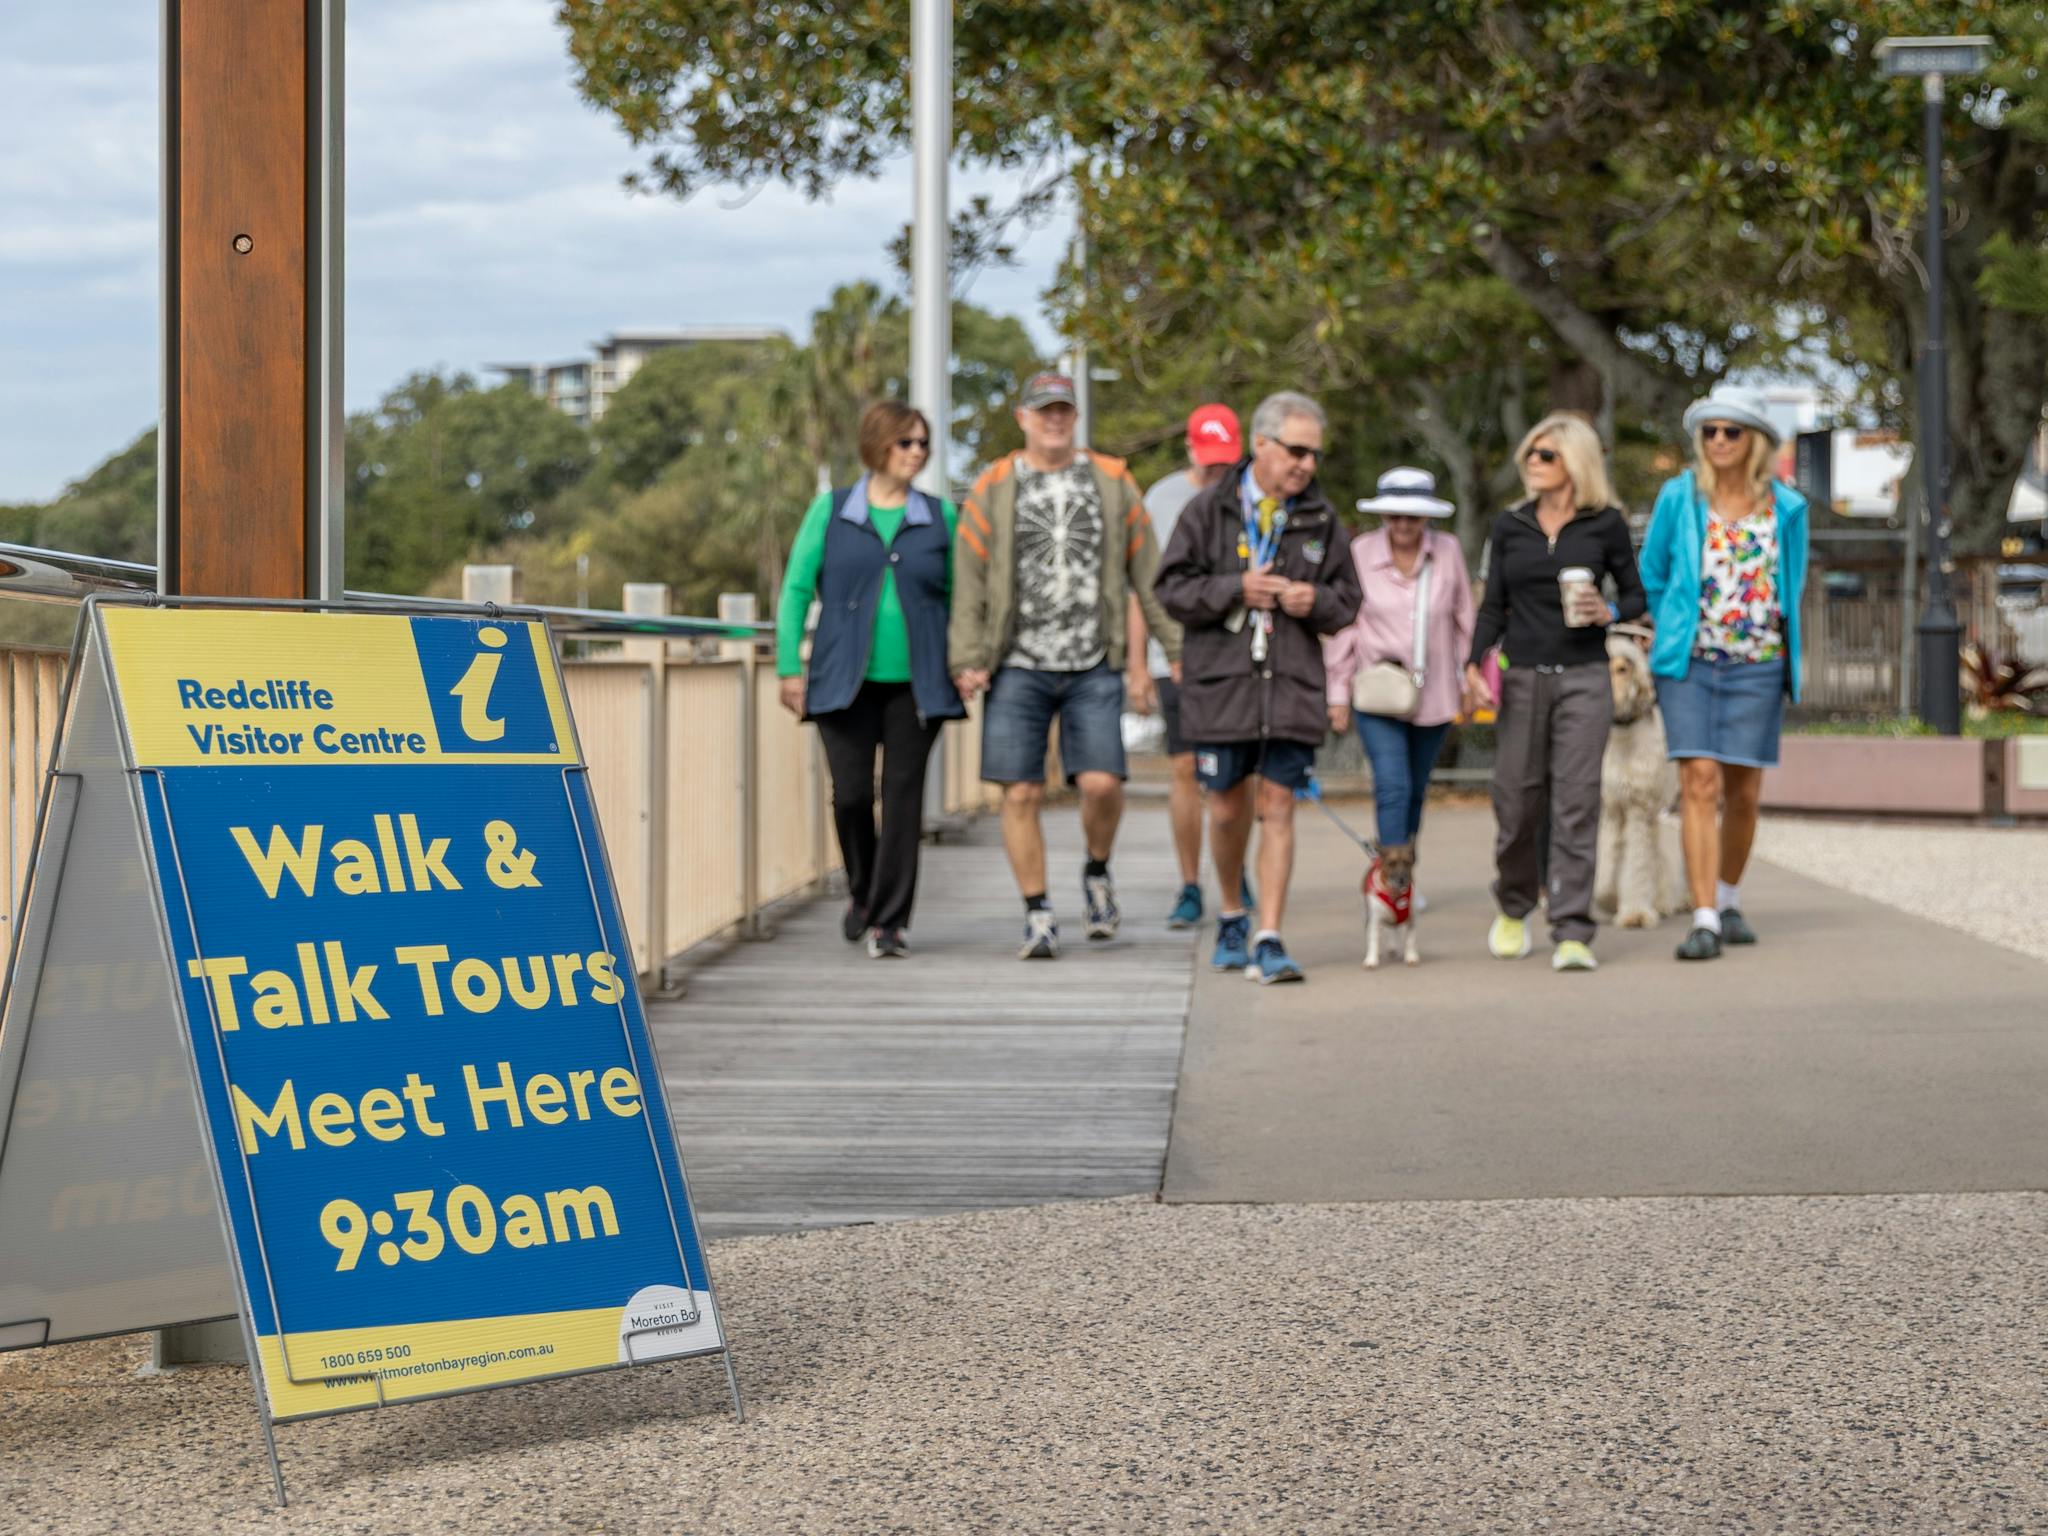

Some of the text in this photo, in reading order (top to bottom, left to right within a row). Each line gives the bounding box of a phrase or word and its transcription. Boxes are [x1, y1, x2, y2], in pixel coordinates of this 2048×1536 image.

[177, 679, 334, 710] Redcliffe
[187, 723, 426, 755] Visitor Centre
[230, 814, 542, 899] Walk &
[188, 941, 389, 1031] Talk
[395, 944, 625, 1016] Tours
[231, 1073, 445, 1155] Meet
[463, 1061, 643, 1131] Here
[319, 1184, 620, 1272] 9:30am
[630, 1313, 679, 1329] Moreton
[654, 1302, 674, 1310] VISIT
[320, 1344, 411, 1369] 1800 659 500
